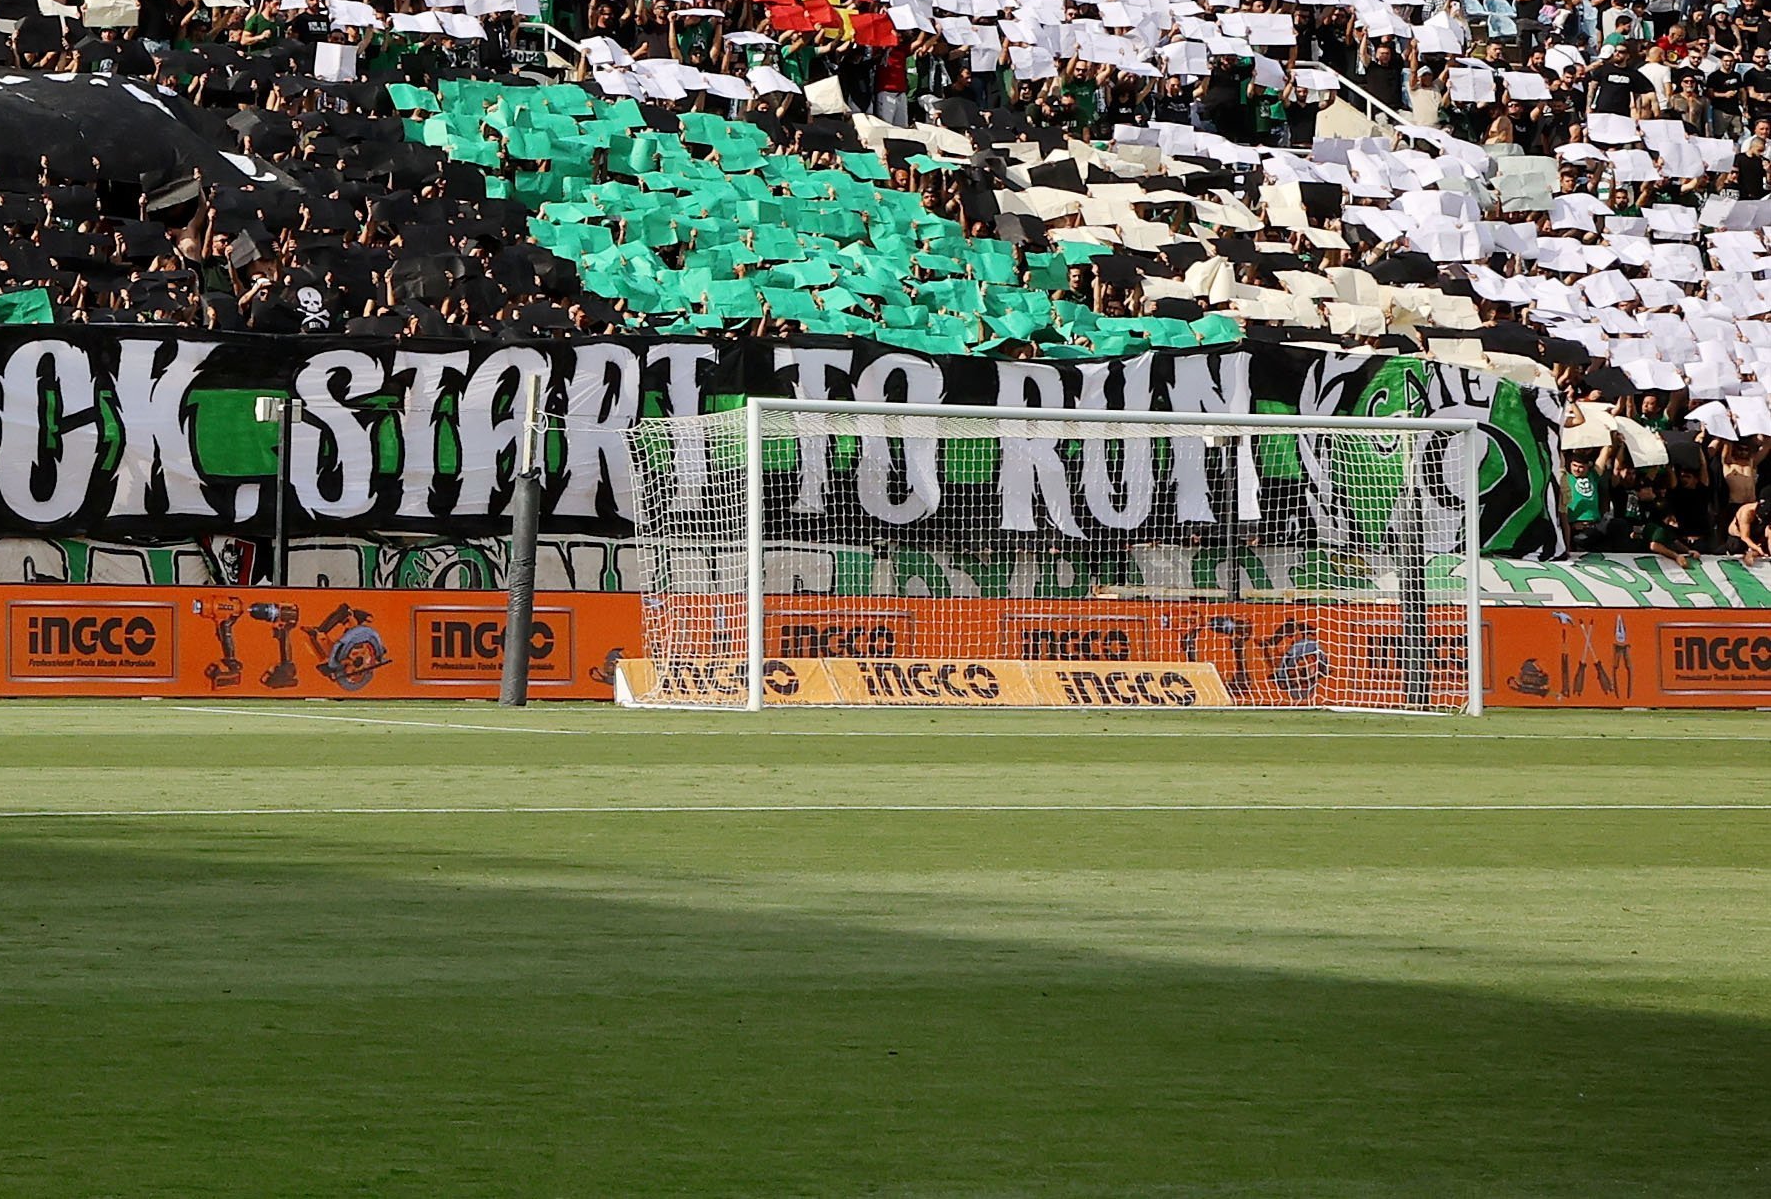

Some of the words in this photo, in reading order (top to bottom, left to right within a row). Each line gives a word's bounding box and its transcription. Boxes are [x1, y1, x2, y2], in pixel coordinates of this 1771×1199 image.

[293, 342, 718, 523] START
[775, 347, 943, 525] TO
[997, 350, 1261, 540] RUN
